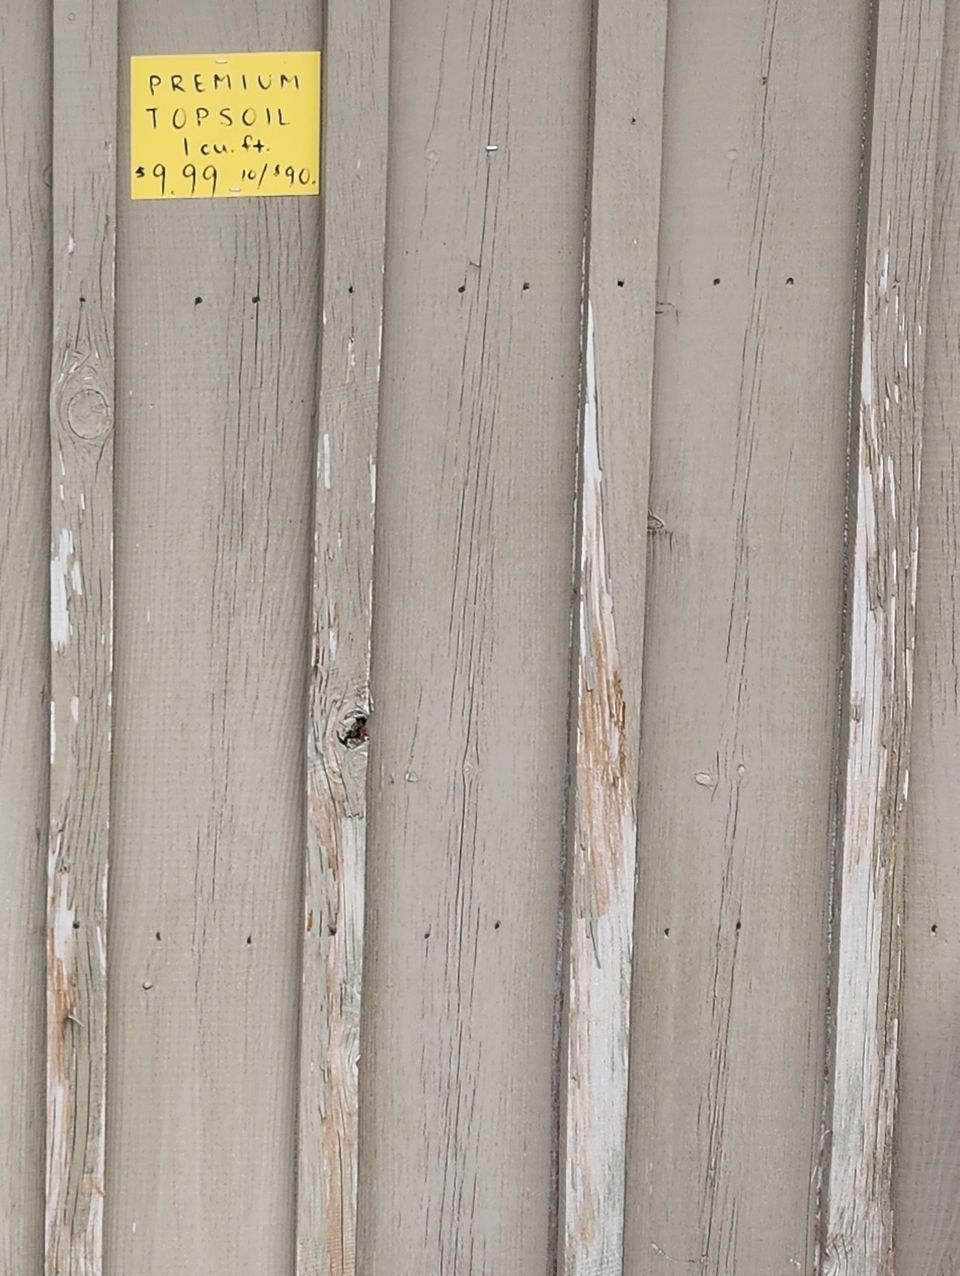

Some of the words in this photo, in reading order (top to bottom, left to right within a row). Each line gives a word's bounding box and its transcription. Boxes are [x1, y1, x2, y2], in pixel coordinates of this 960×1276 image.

[149, 74, 300, 96] PREMIUM
[145, 107, 290, 129] TOPSOIL
[183, 137, 189, 156] 1
[200, 143, 235, 156] cu.
[241, 134, 271, 153] ft.
[135, 163, 218, 198] $9.99
